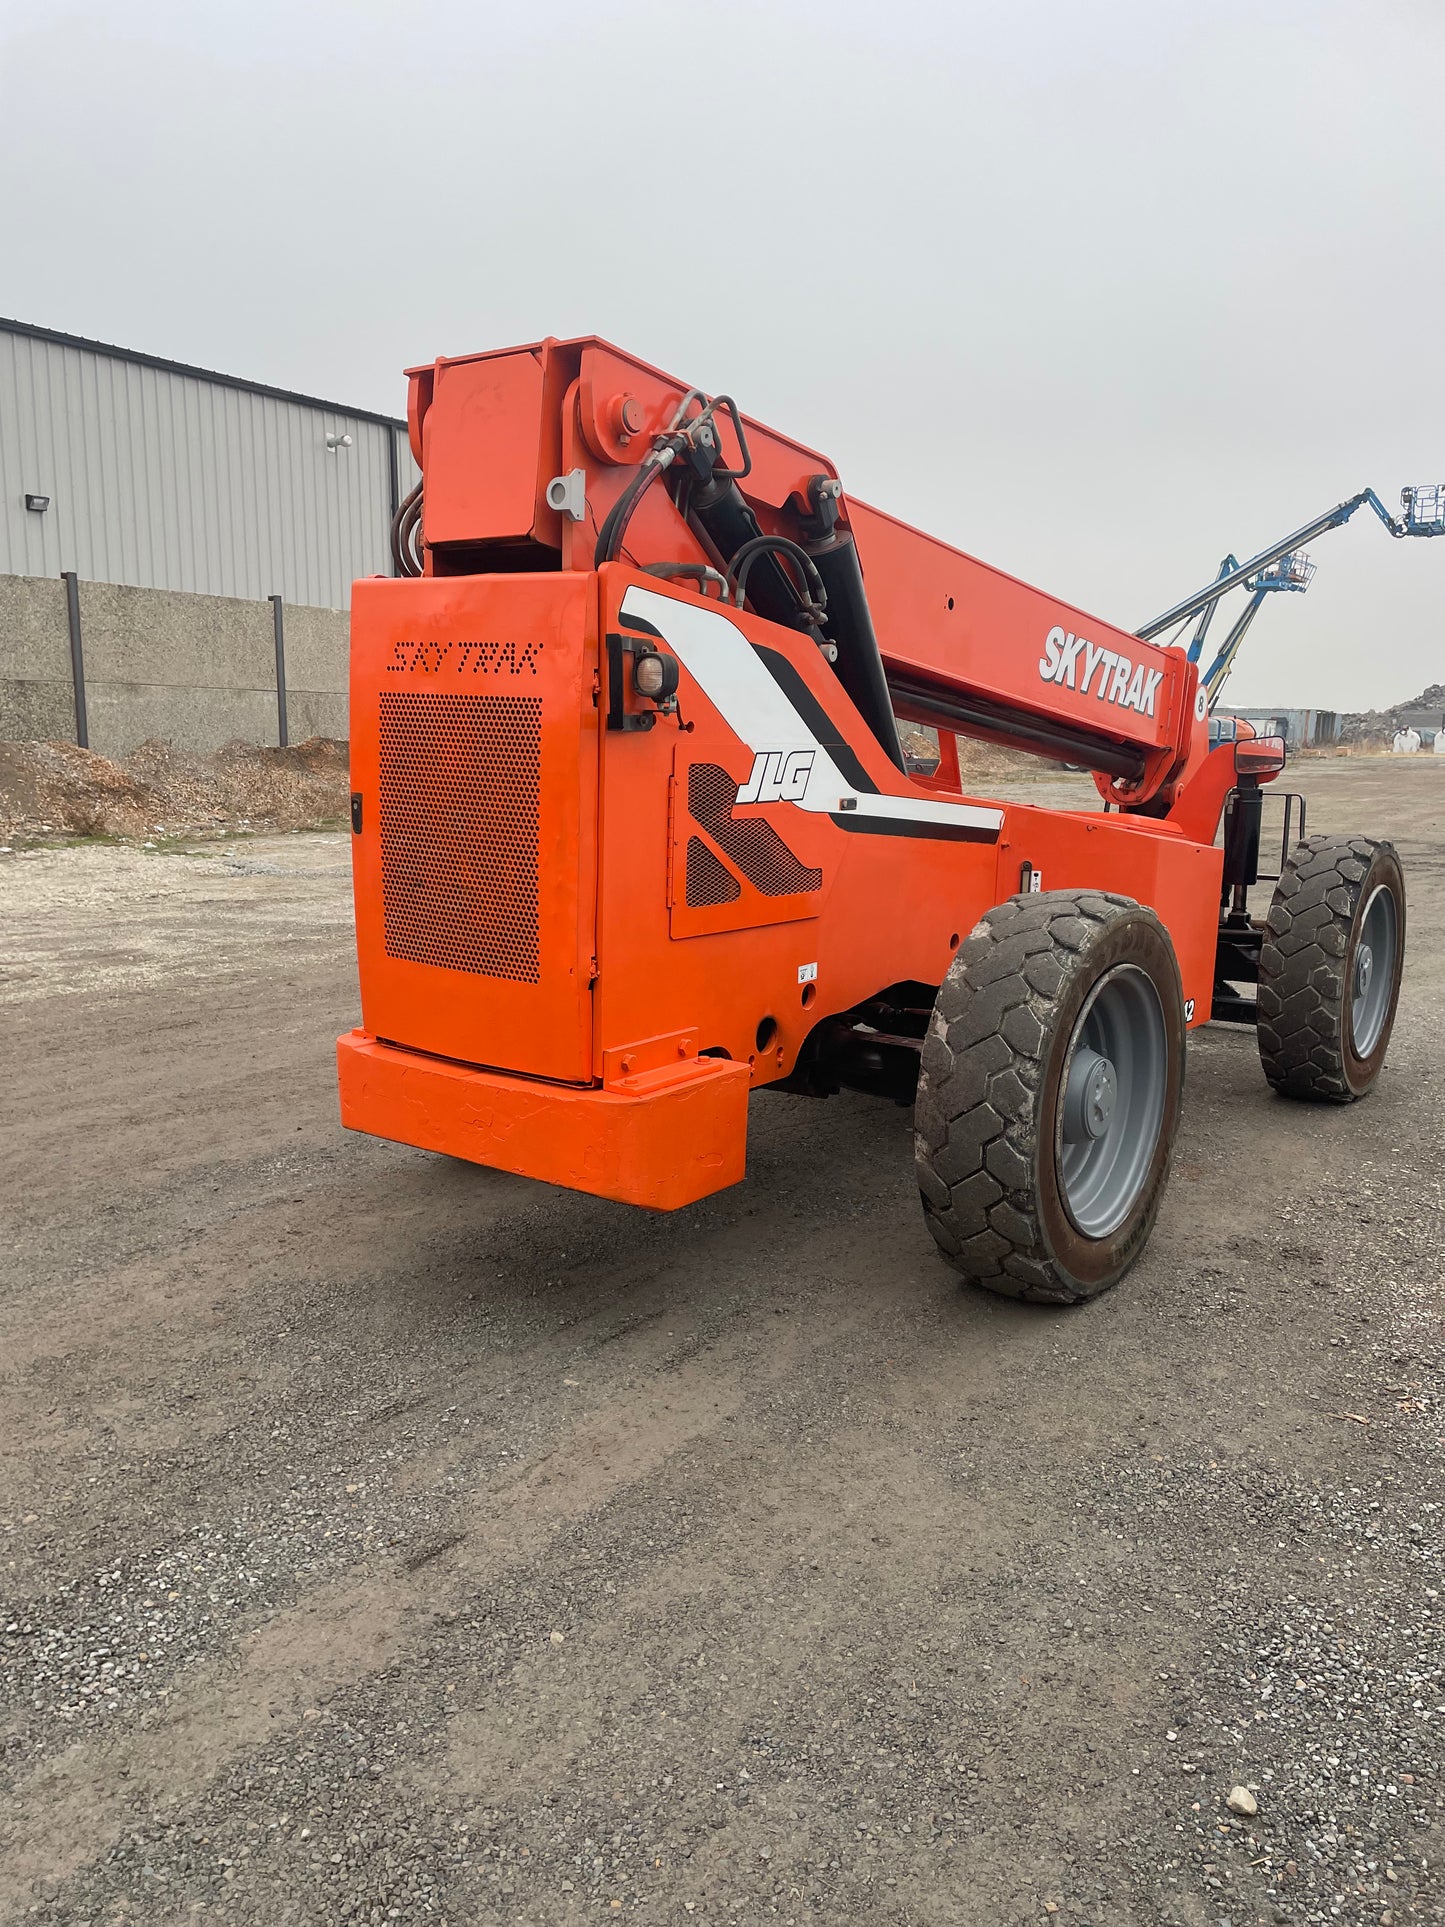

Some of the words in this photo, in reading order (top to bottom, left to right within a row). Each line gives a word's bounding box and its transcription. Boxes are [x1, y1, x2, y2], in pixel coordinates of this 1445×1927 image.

[1038, 625, 1164, 718] SKYTRAK
[1197, 695, 1205, 713] 8
[734, 750, 816, 805] JLG
